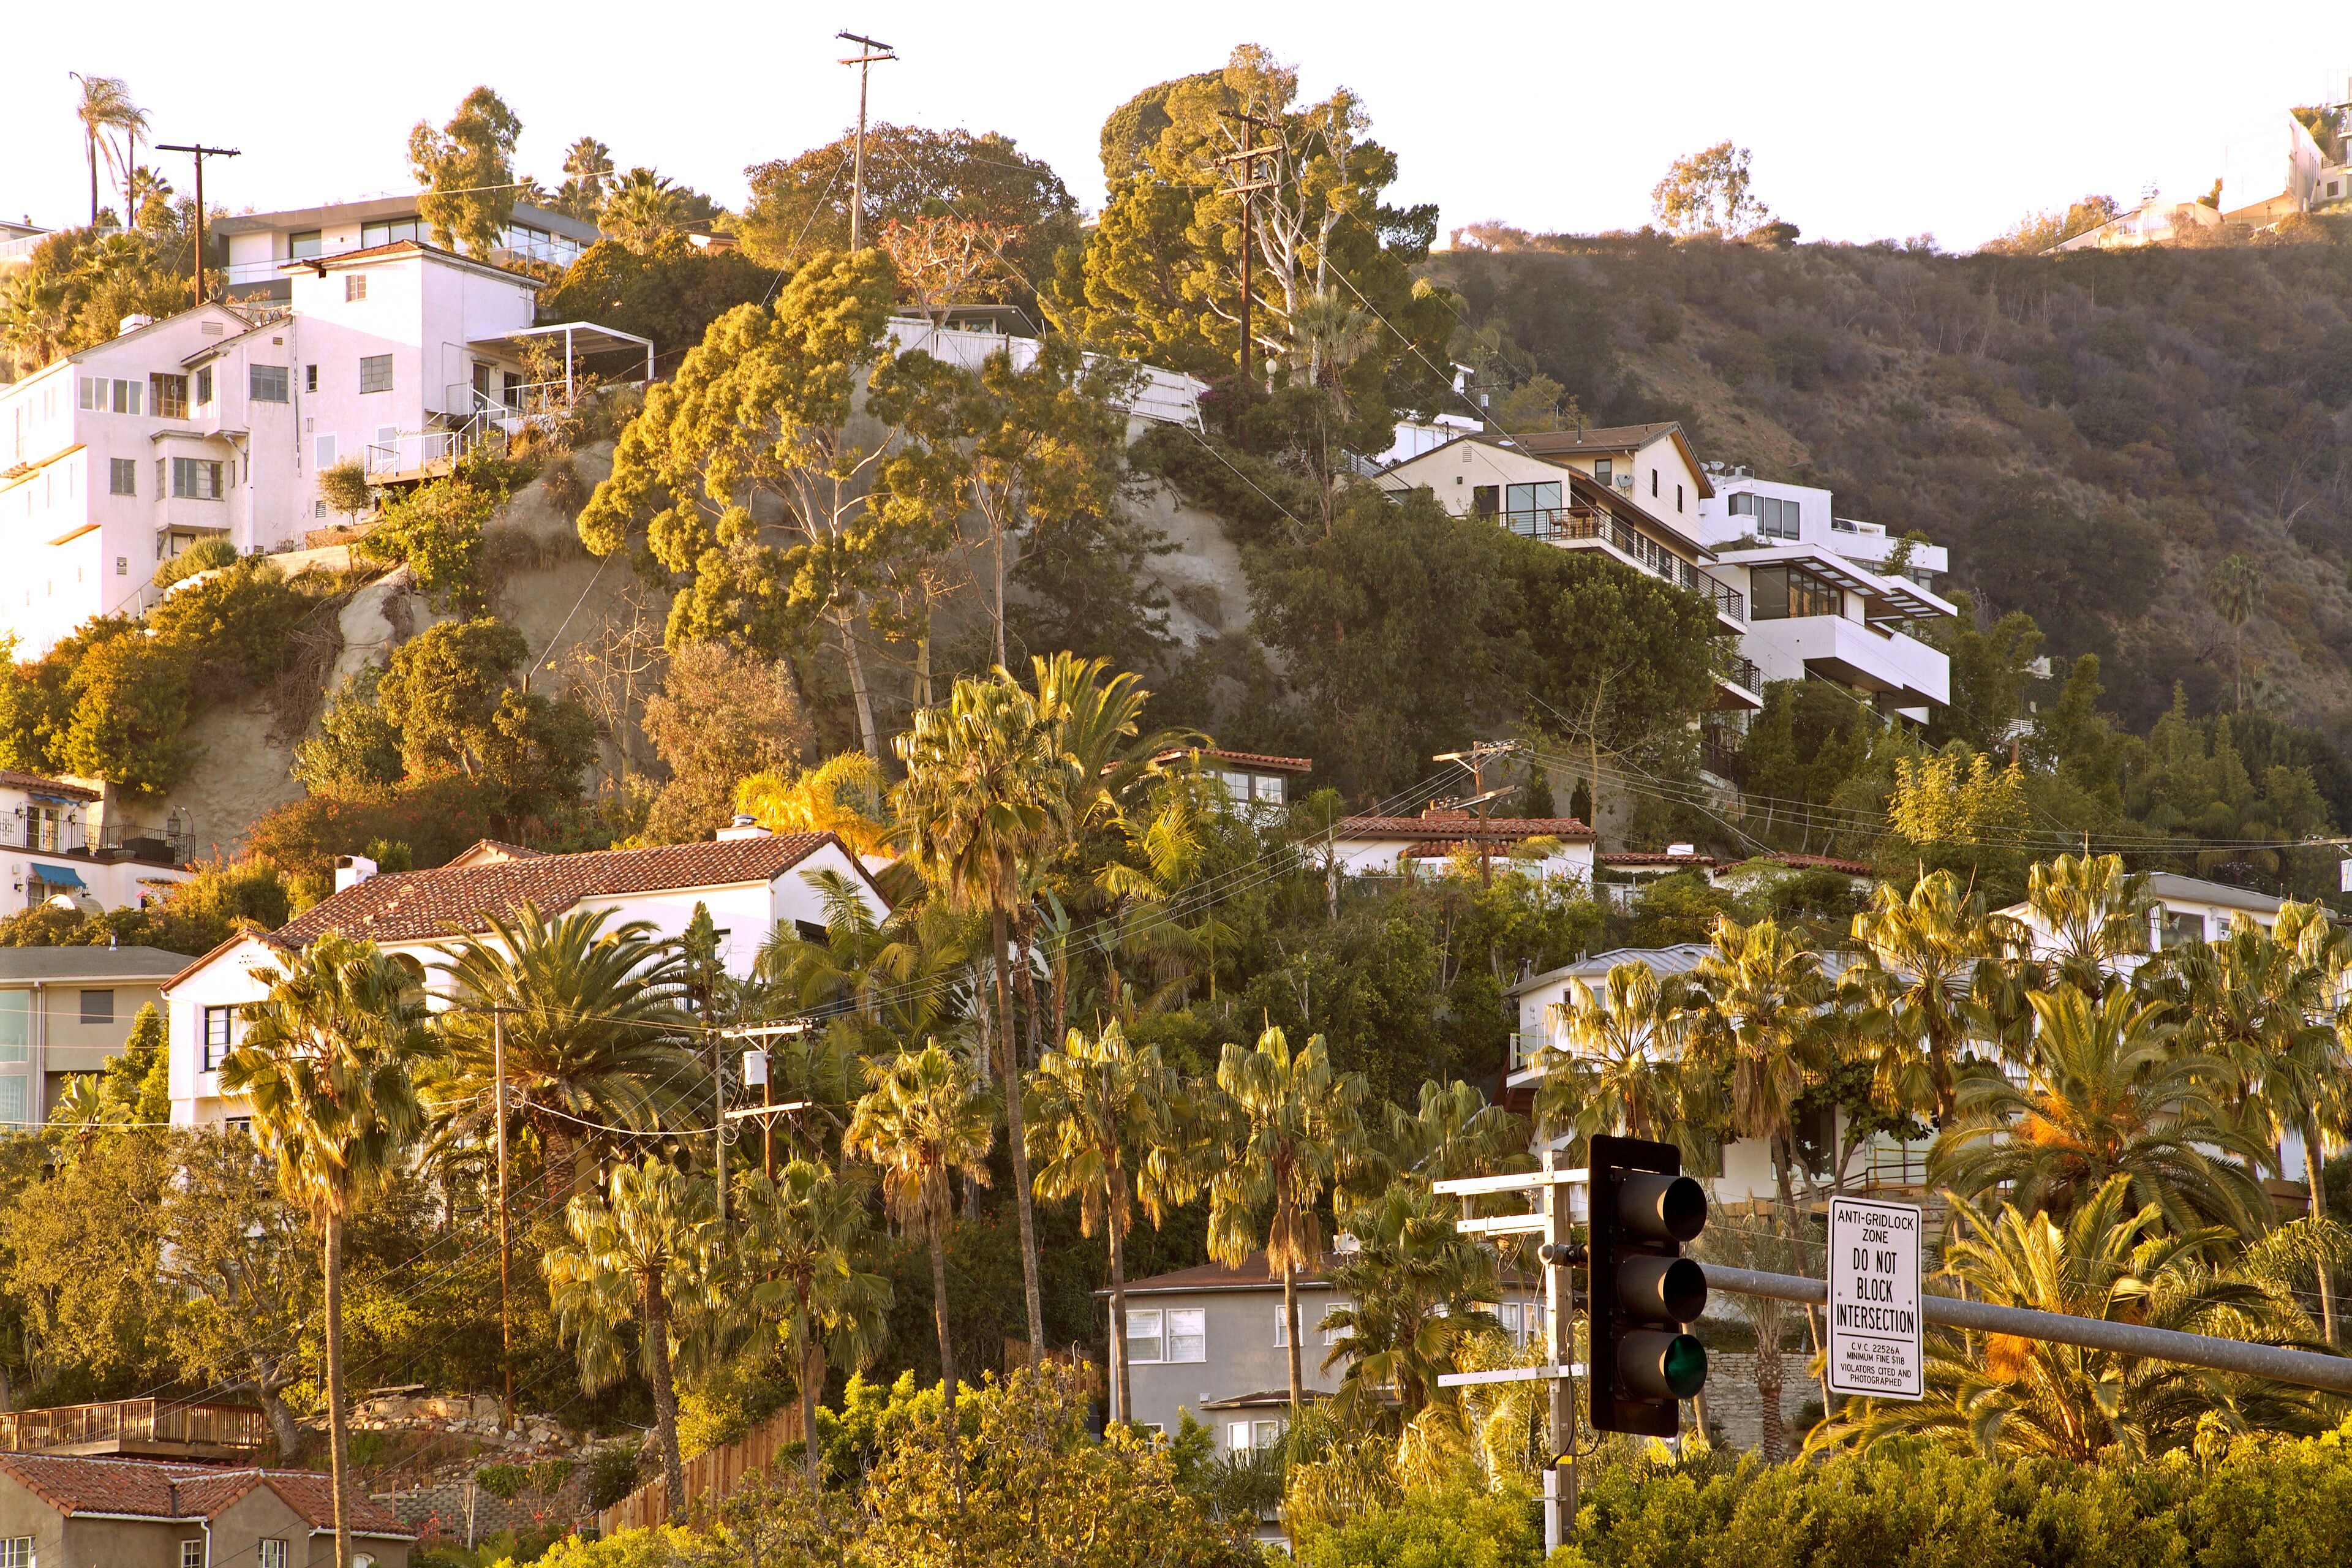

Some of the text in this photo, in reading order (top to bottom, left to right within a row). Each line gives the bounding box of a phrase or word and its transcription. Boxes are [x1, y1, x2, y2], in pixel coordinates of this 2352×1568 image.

[1838, 1210, 1913, 1231] ANTI-GRIDLOCK
[1863, 1229, 1888, 1243] ZONE
[1853, 1248, 1897, 1275] DO NOT
[1857, 1277, 1893, 1303] BLOCK
[1837, 1303, 1914, 1333] INTERSECTION
[1852, 1342, 1900, 1355] C.V.C. 22526A
[1847, 1352, 1873, 1362] MINIMUM
[1892, 1356, 1905, 1365] $118
[1841, 1363, 1911, 1378] VIOLATORS CITED AND
[1850, 1374, 1902, 1386] PHOTOGRAPHED
